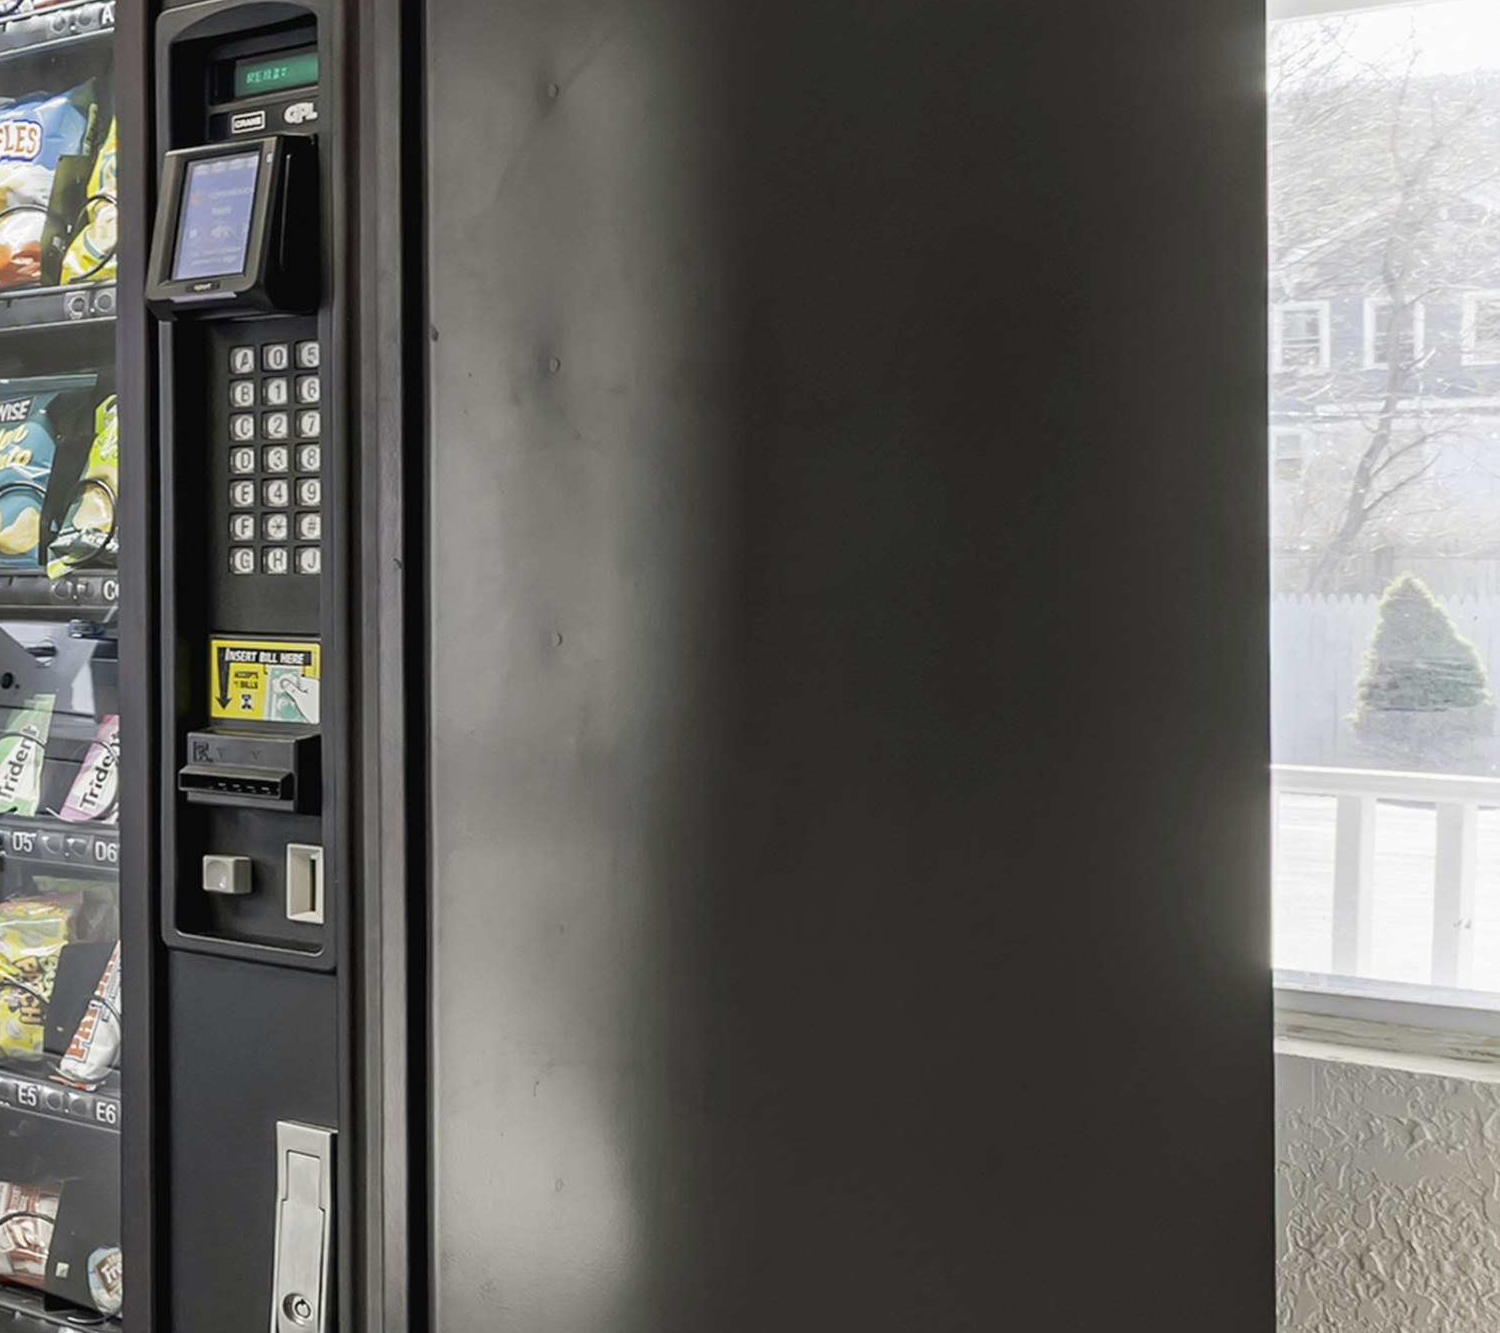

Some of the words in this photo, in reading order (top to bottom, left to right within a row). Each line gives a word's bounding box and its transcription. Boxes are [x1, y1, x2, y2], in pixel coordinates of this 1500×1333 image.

[102, 6, 115, 25] A
[240, 351, 250, 368] A
[306, 345, 316, 365] 5
[240, 385, 250, 404] B
[275, 383, 282, 401] 1
[307, 379, 317, 398] 6
[240, 418, 250, 437] C
[273, 416, 283, 435] 2
[307, 414, 316, 432] 7
[240, 451, 251, 470] D
[272, 449, 283, 469] 3
[307, 448, 317, 467] 8
[240, 485, 250, 503] E
[273, 483, 284, 502] 4
[307, 481, 316, 501] 9
[240, 517, 250, 536] F
[240, 550, 251, 569] G
[273, 551, 284, 569] H
[307, 551, 317, 570] J
[224, 647, 258, 662] INSERT
[259, 651, 278, 664] BILL
[280, 652, 305, 665] HERE
[12, 833, 34, 853] D5
[95, 840, 119, 863] D6
[17, 1086, 37, 1106] E5
[96, 1102, 117, 1124] E6
